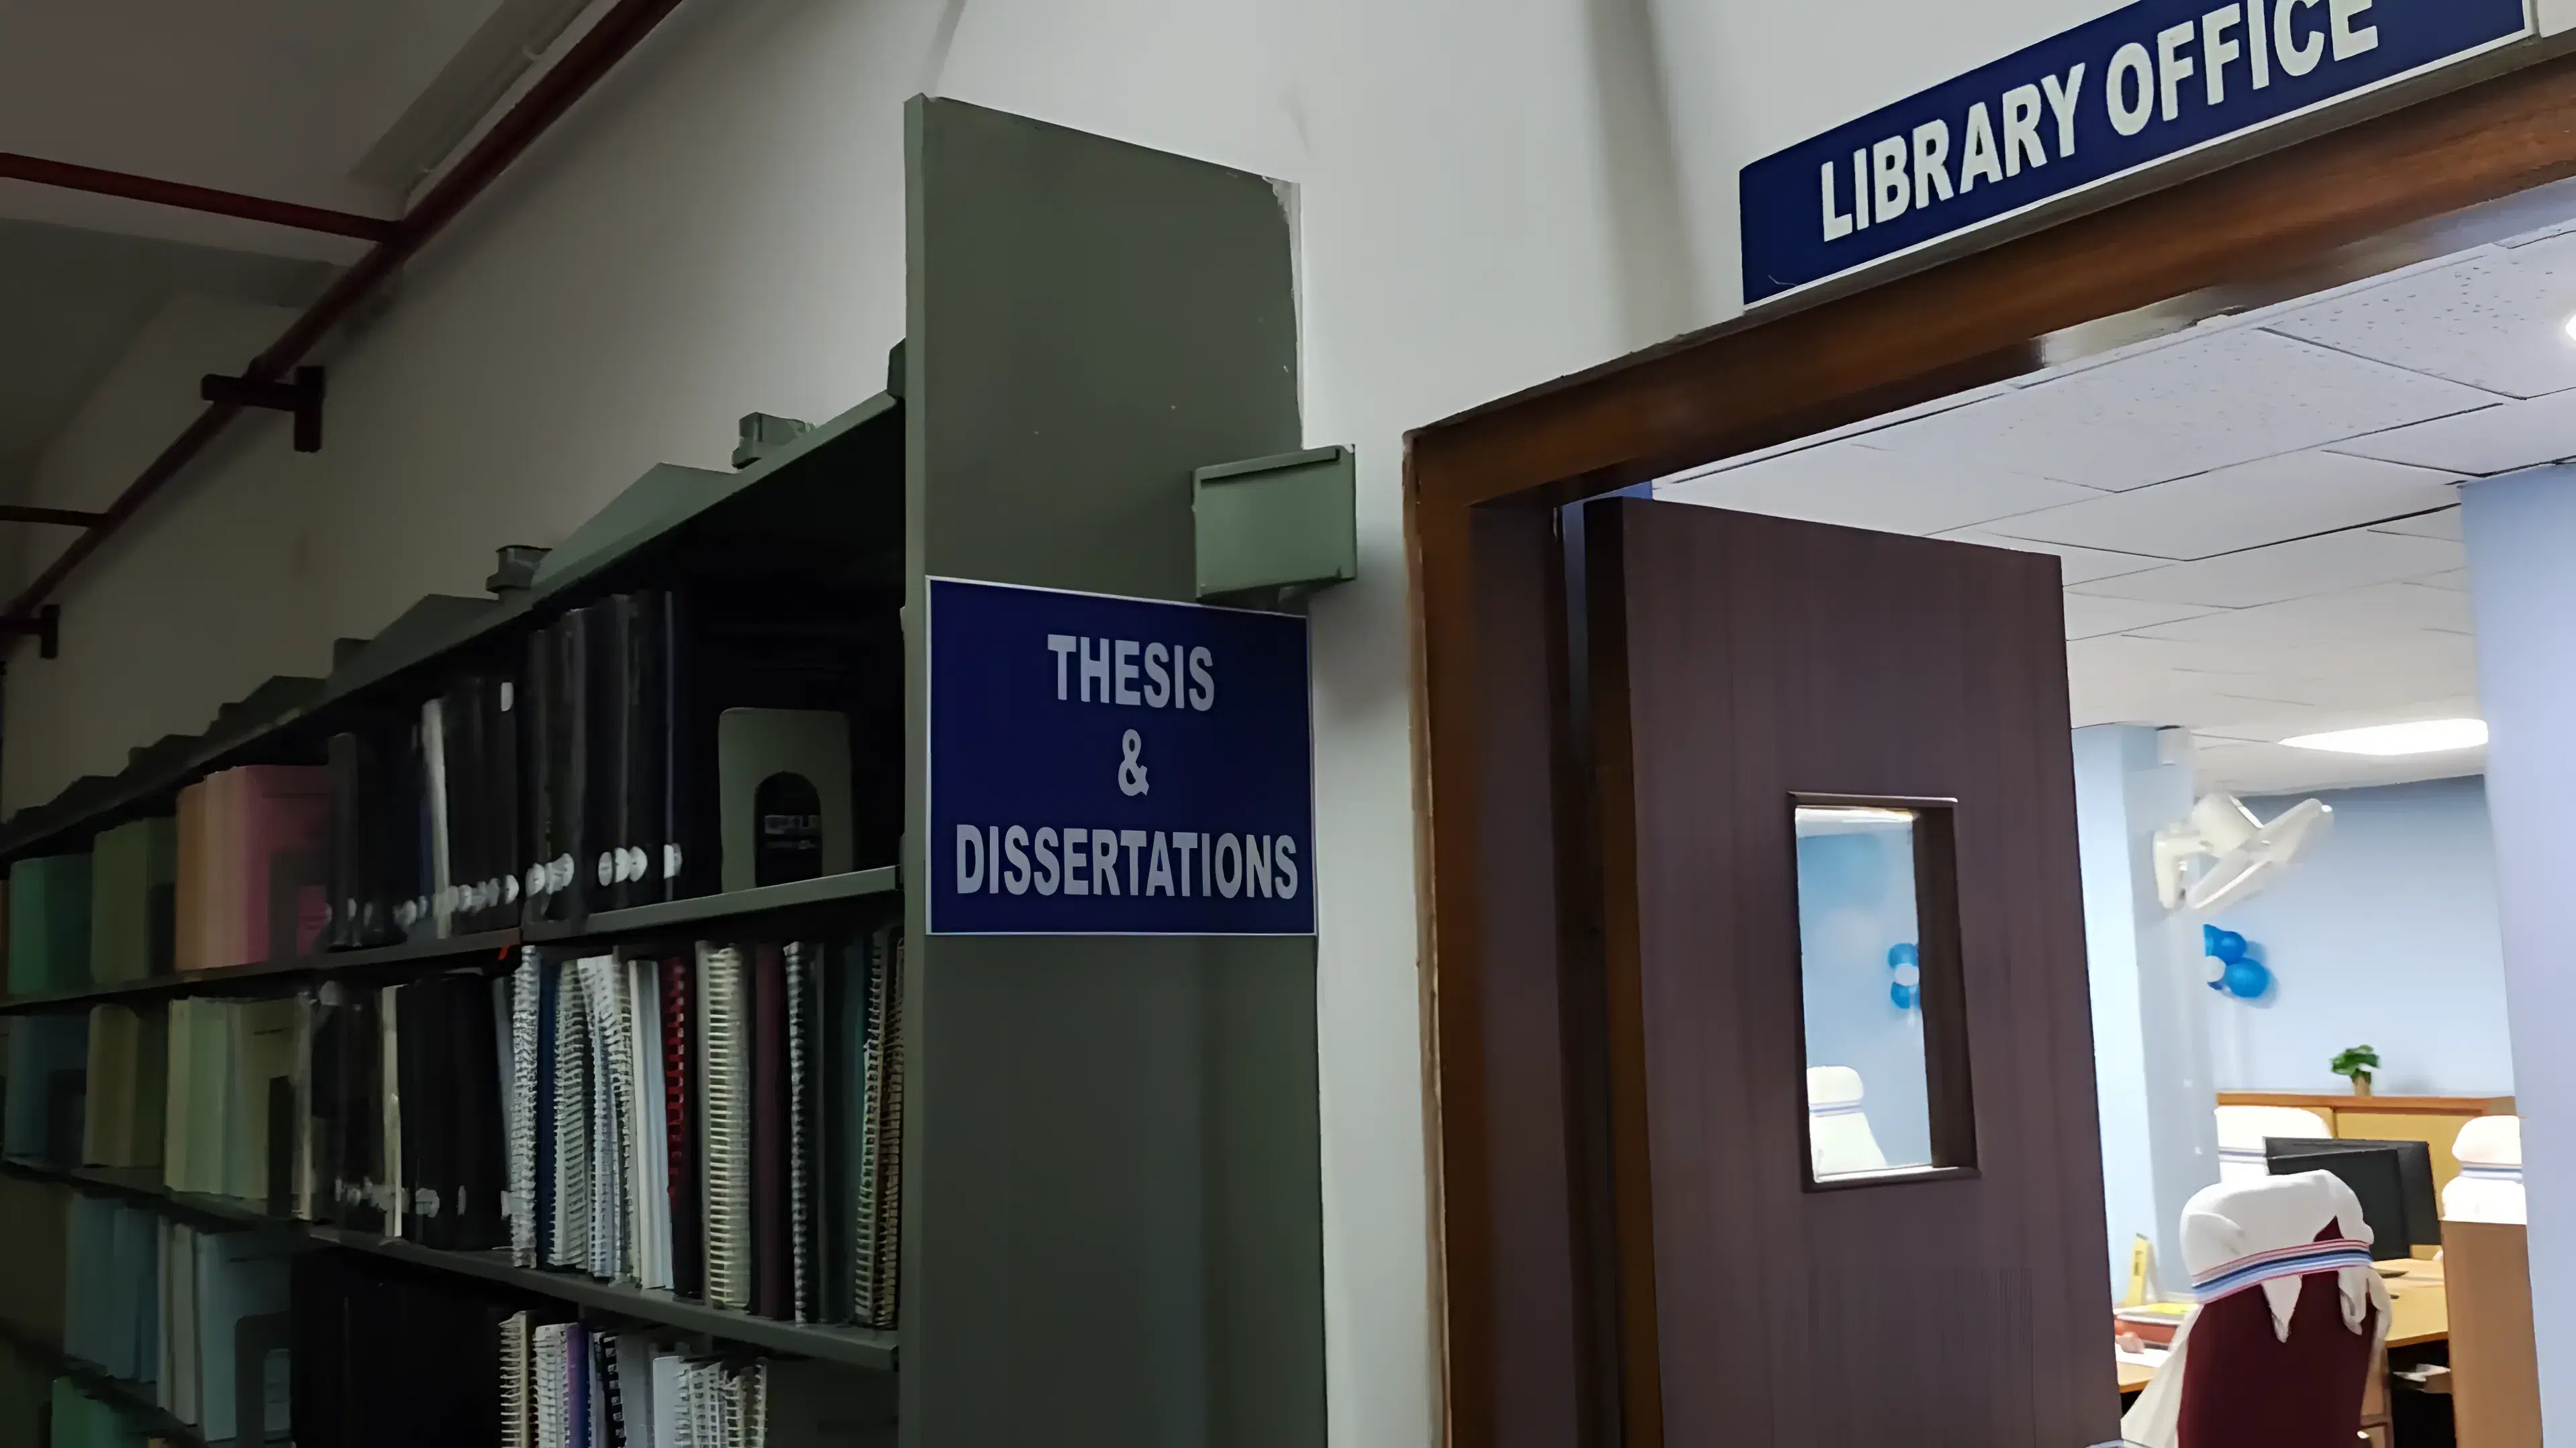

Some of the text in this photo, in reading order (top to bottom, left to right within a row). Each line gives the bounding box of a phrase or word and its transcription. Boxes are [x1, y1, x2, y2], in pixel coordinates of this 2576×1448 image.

[1821, 0, 2379, 242] LIBRARY OFFICE
[1047, 633, 1214, 711] THESIS
[1118, 729, 1150, 796] &
[956, 824, 1298, 900] DISSERTATIONS
